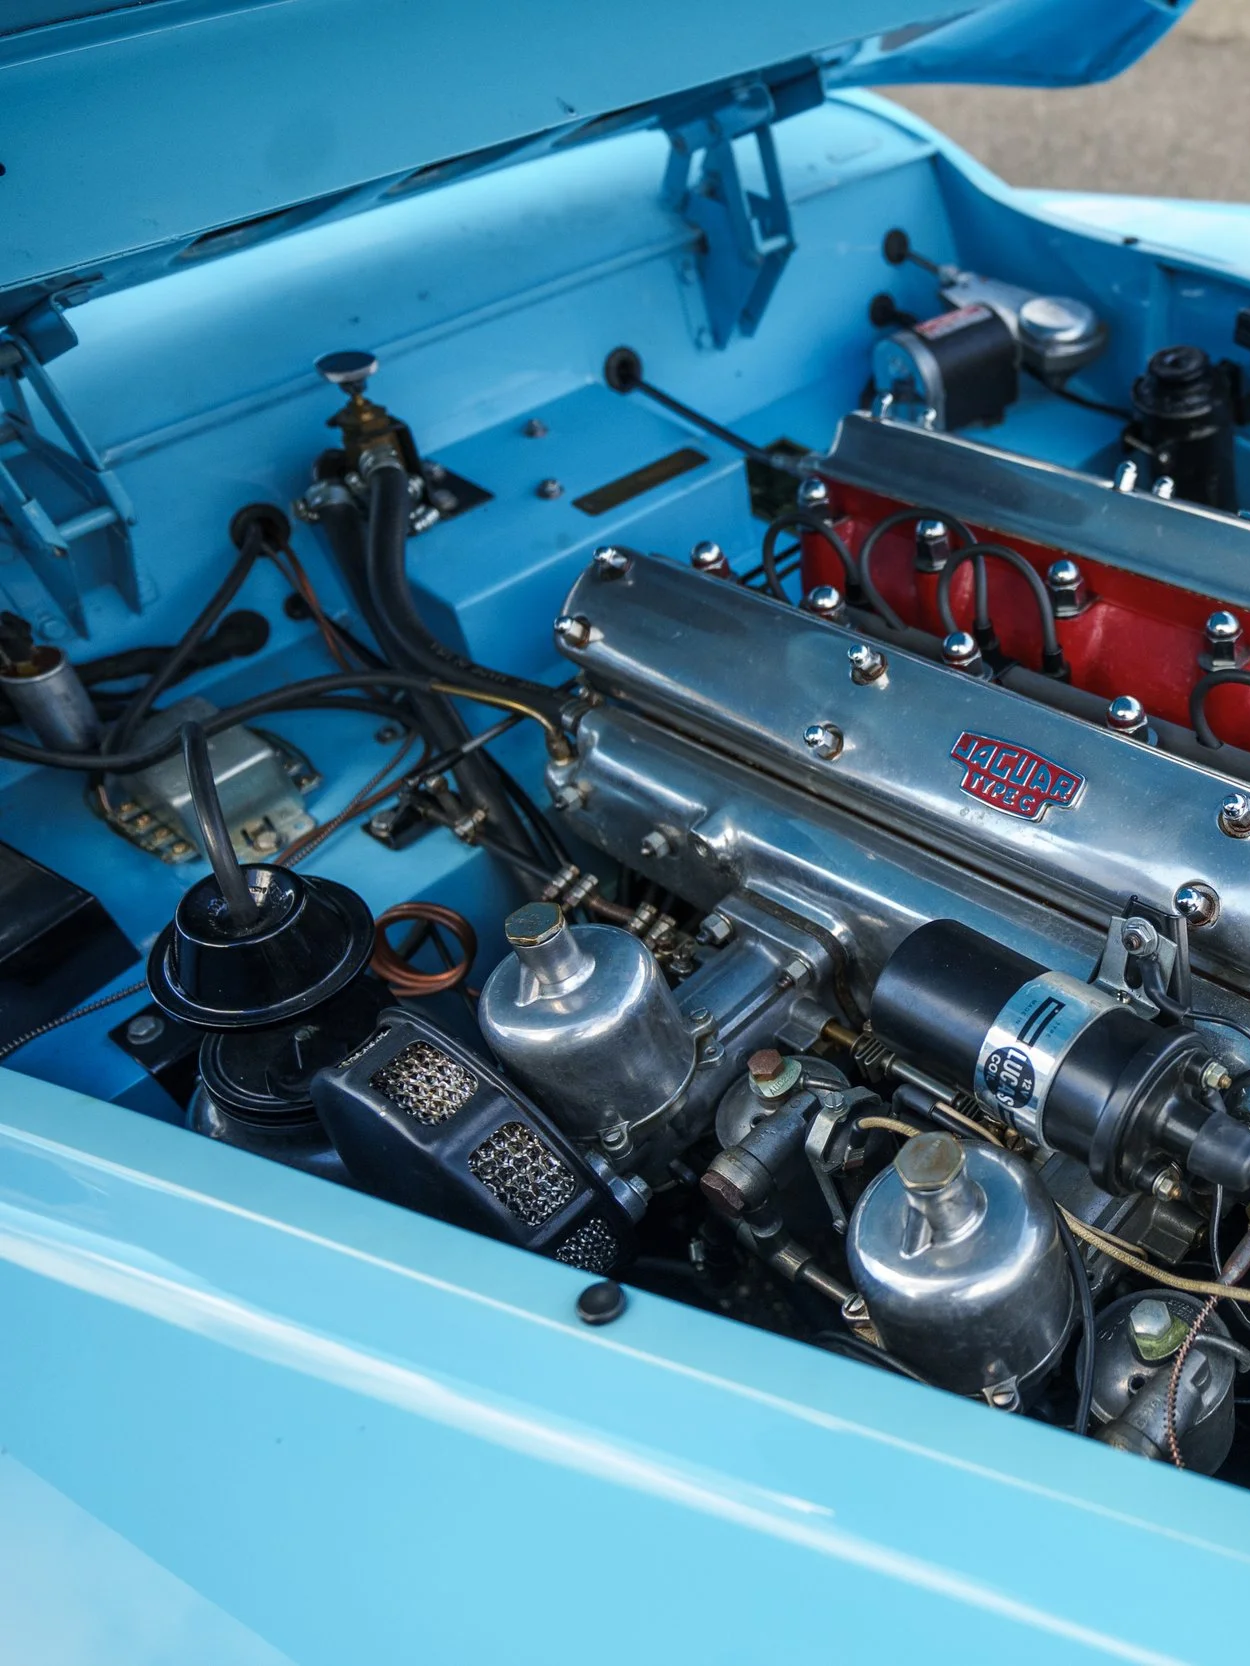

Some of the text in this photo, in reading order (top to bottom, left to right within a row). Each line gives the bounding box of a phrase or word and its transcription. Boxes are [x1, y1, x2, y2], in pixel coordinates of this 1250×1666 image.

[956, 739, 1076, 800] JAGUAR
[970, 772, 1036, 812] TYPE C
[986, 1053, 1001, 1081] COIL
[996, 1048, 1027, 1107] LUCAS
[1020, 1078, 1033, 1095] 12V
